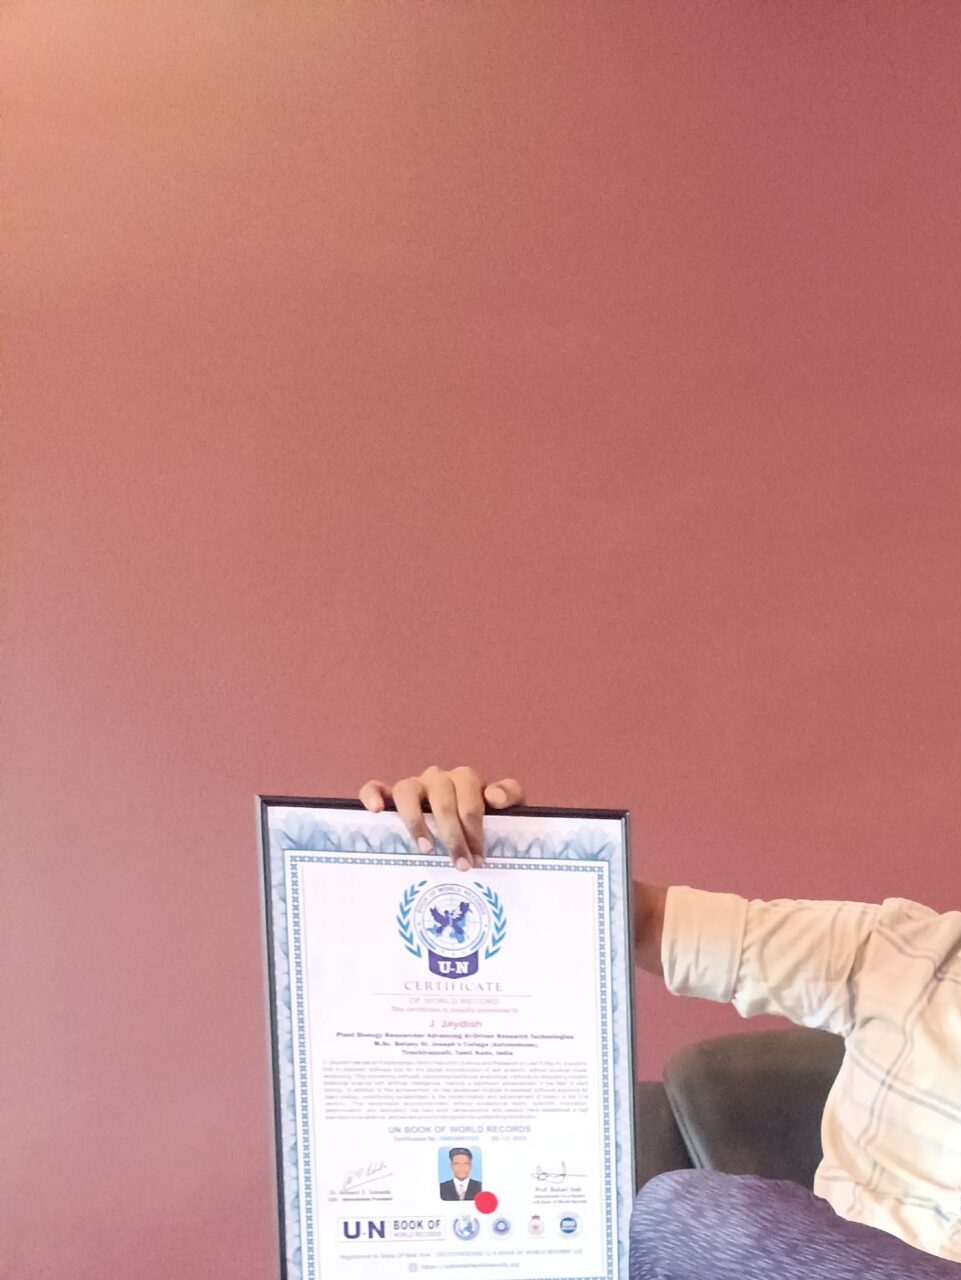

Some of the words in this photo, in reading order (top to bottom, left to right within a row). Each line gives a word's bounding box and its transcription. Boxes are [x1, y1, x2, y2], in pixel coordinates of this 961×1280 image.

[437, 961, 470, 974] U-N
[404, 981, 504, 992] CERTIFICATE
[441, 1019, 483, 1030] Jaydish
[393, 1220, 424, 1230] BOOK
[427, 1219, 441, 1229] OF
